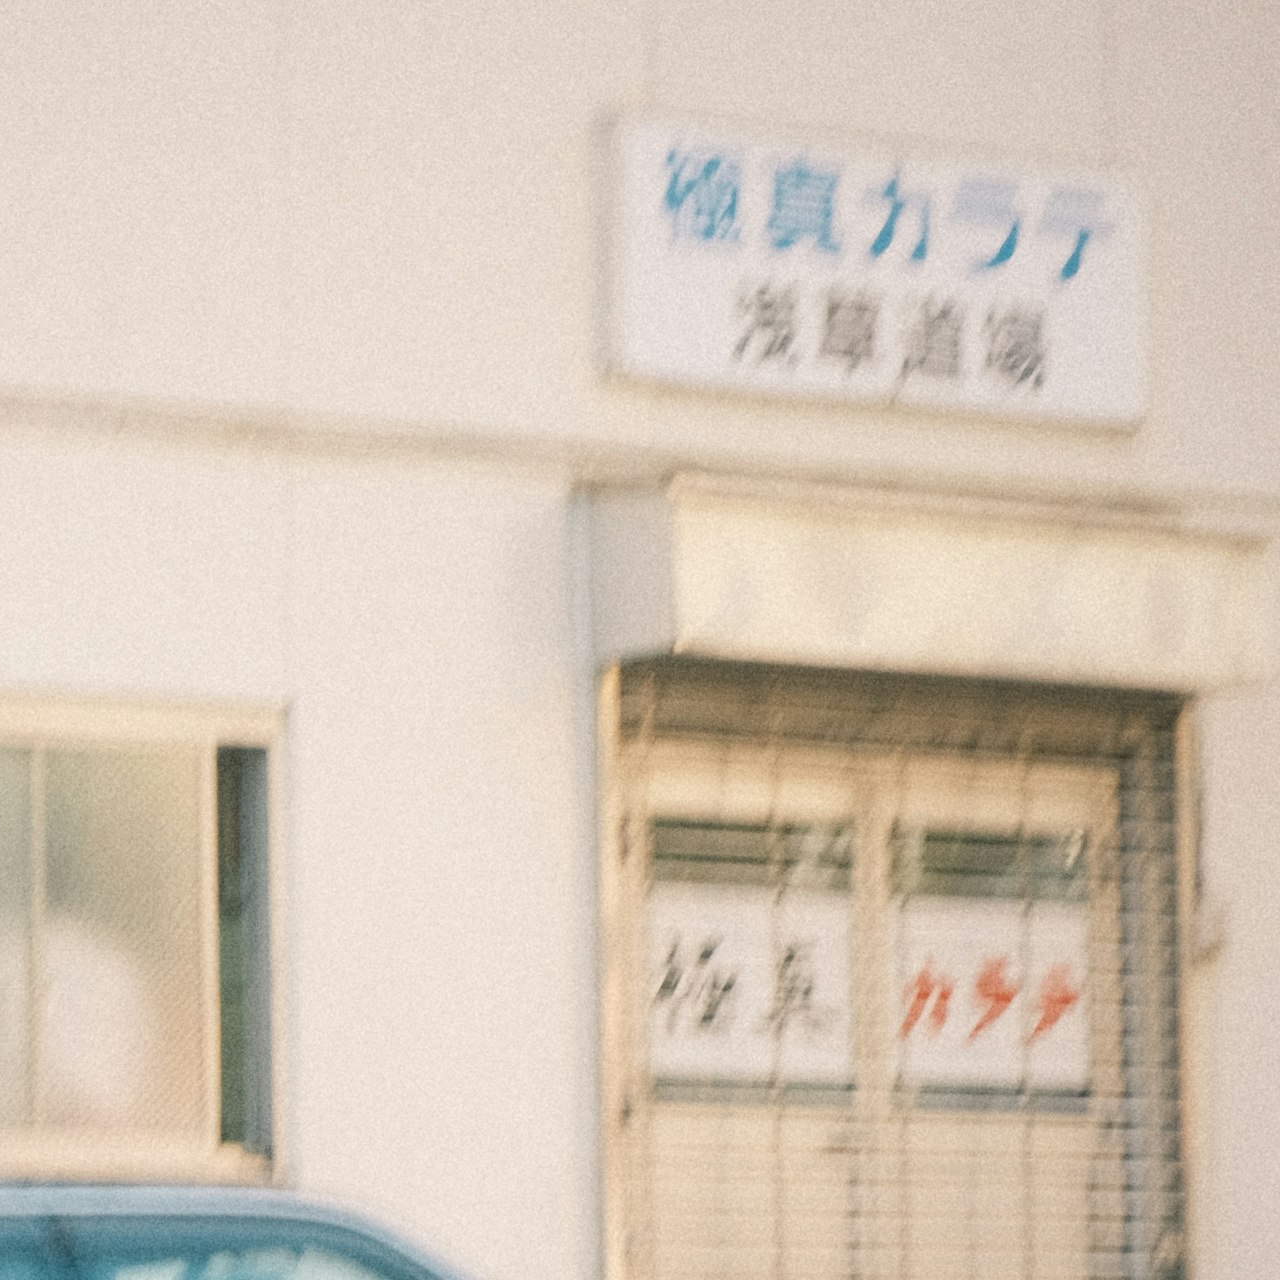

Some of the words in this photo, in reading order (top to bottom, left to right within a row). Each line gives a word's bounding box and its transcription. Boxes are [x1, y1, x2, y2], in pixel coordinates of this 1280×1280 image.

[662, 150, 1116, 282] 極真カラテ
[900, 958, 1079, 1045] カラテ
